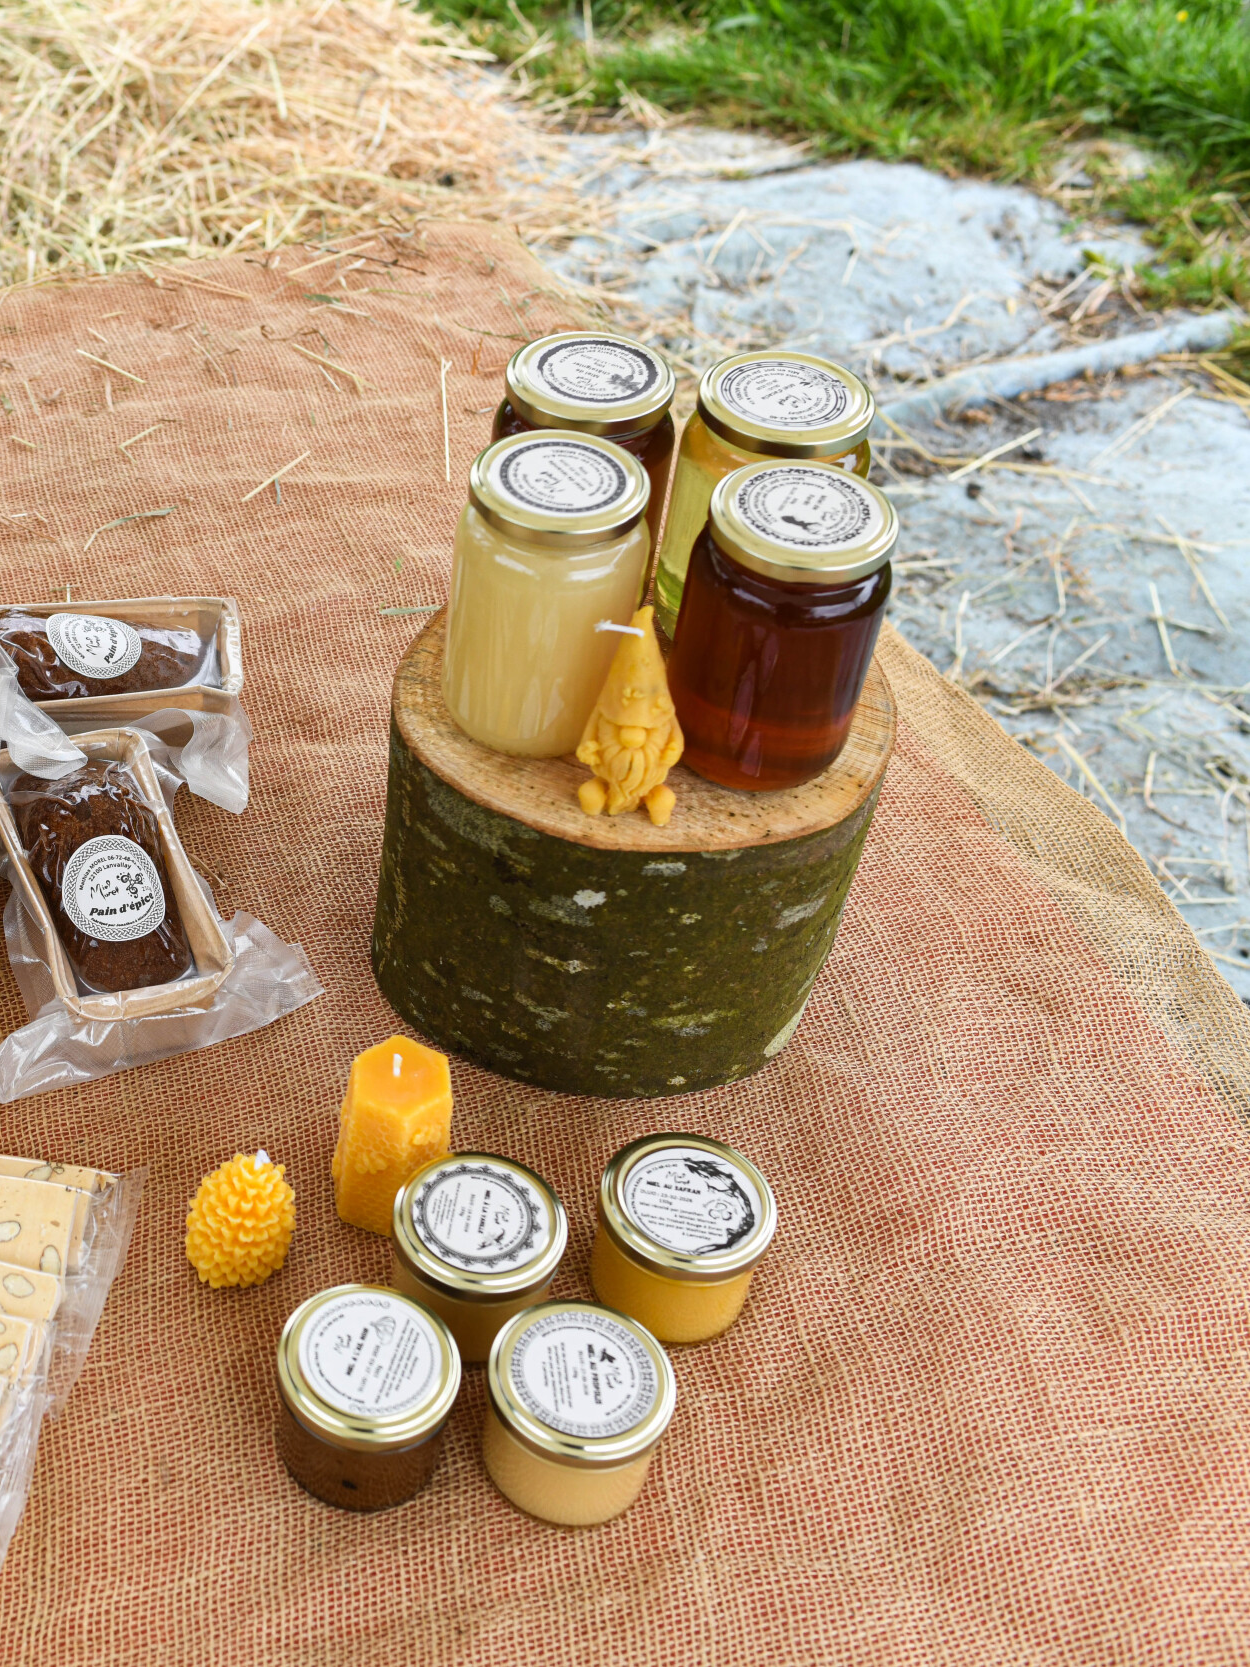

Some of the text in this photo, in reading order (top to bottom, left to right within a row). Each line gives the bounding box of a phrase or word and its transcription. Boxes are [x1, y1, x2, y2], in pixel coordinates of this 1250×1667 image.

[103, 644, 118, 664] Pain
[79, 867, 91, 891] Mathias
[89, 856, 107, 869] MOREL
[88, 862, 132, 882] 22100 Lanvallay
[89, 892, 155, 917] Pain d'épice
[645, 1179, 660, 1188] MIEL
[674, 1184, 701, 1195] SAFRAN
